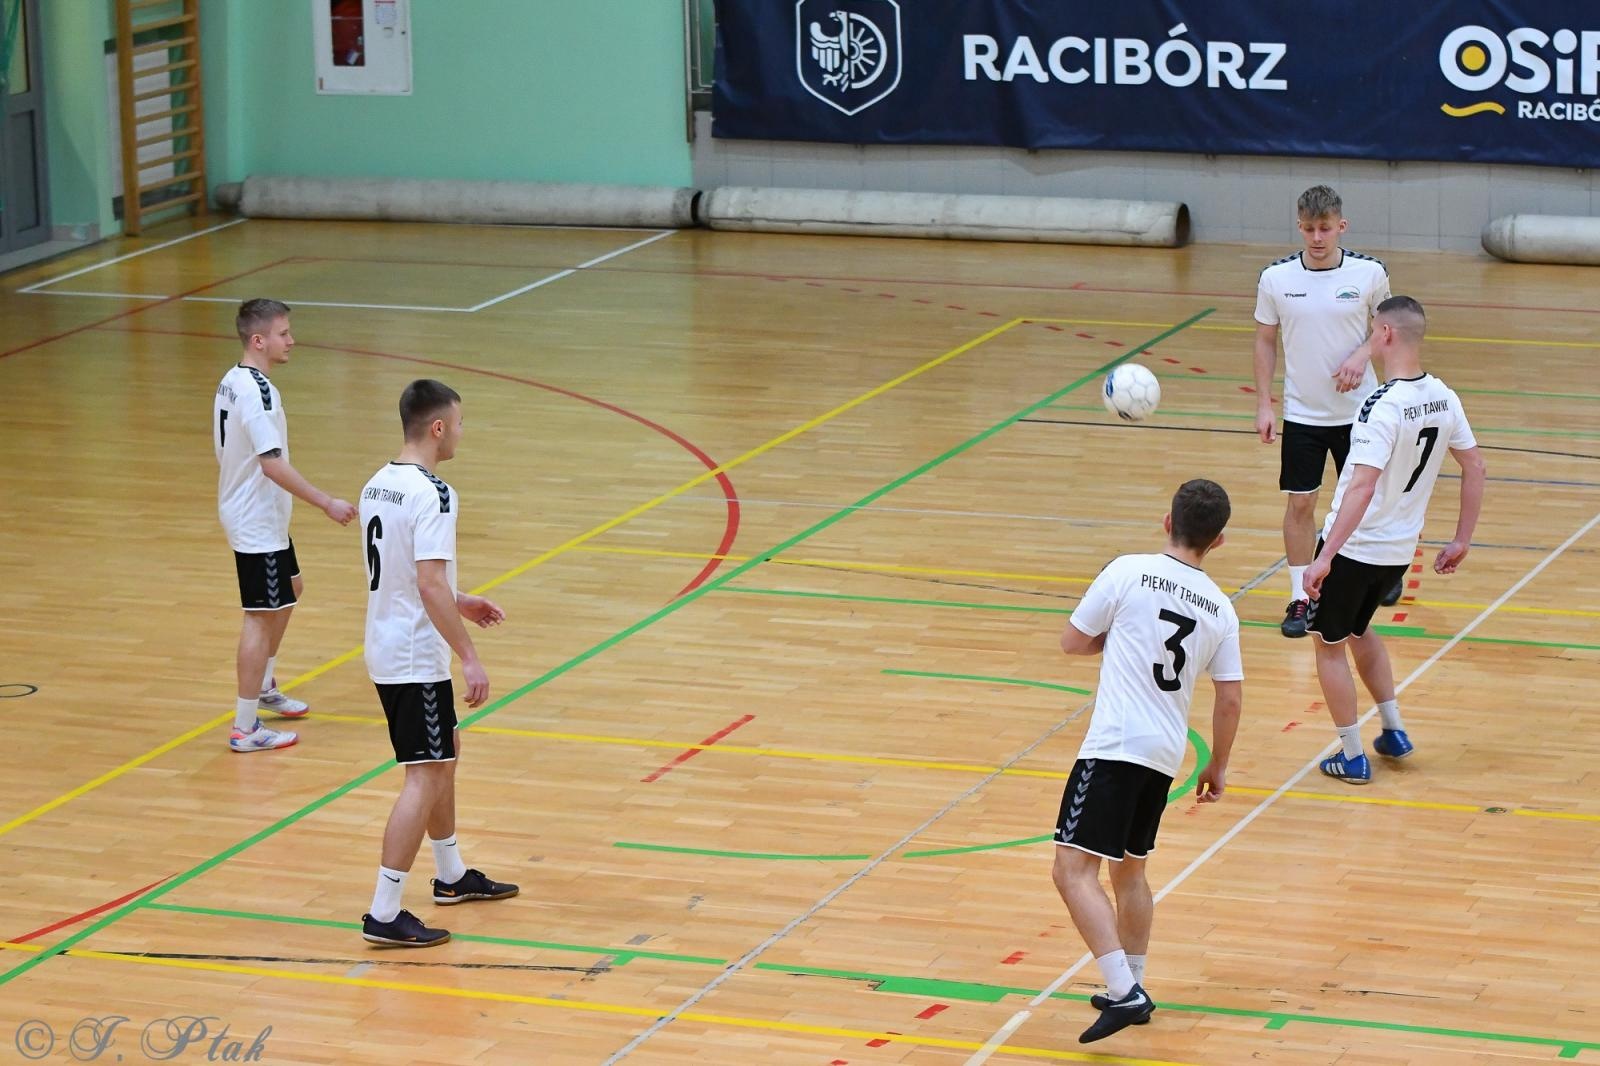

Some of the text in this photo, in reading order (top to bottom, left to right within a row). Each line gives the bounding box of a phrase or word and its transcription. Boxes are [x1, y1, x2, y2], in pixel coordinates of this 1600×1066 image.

[963, 22, 1288, 91] RACIBÓRZ
[1402, 426, 1439, 494] 7
[366, 514, 383, 592] 6
[1141, 574, 1220, 618] PIĘKNY TRAWNIK
[1152, 608, 1197, 692] 3
